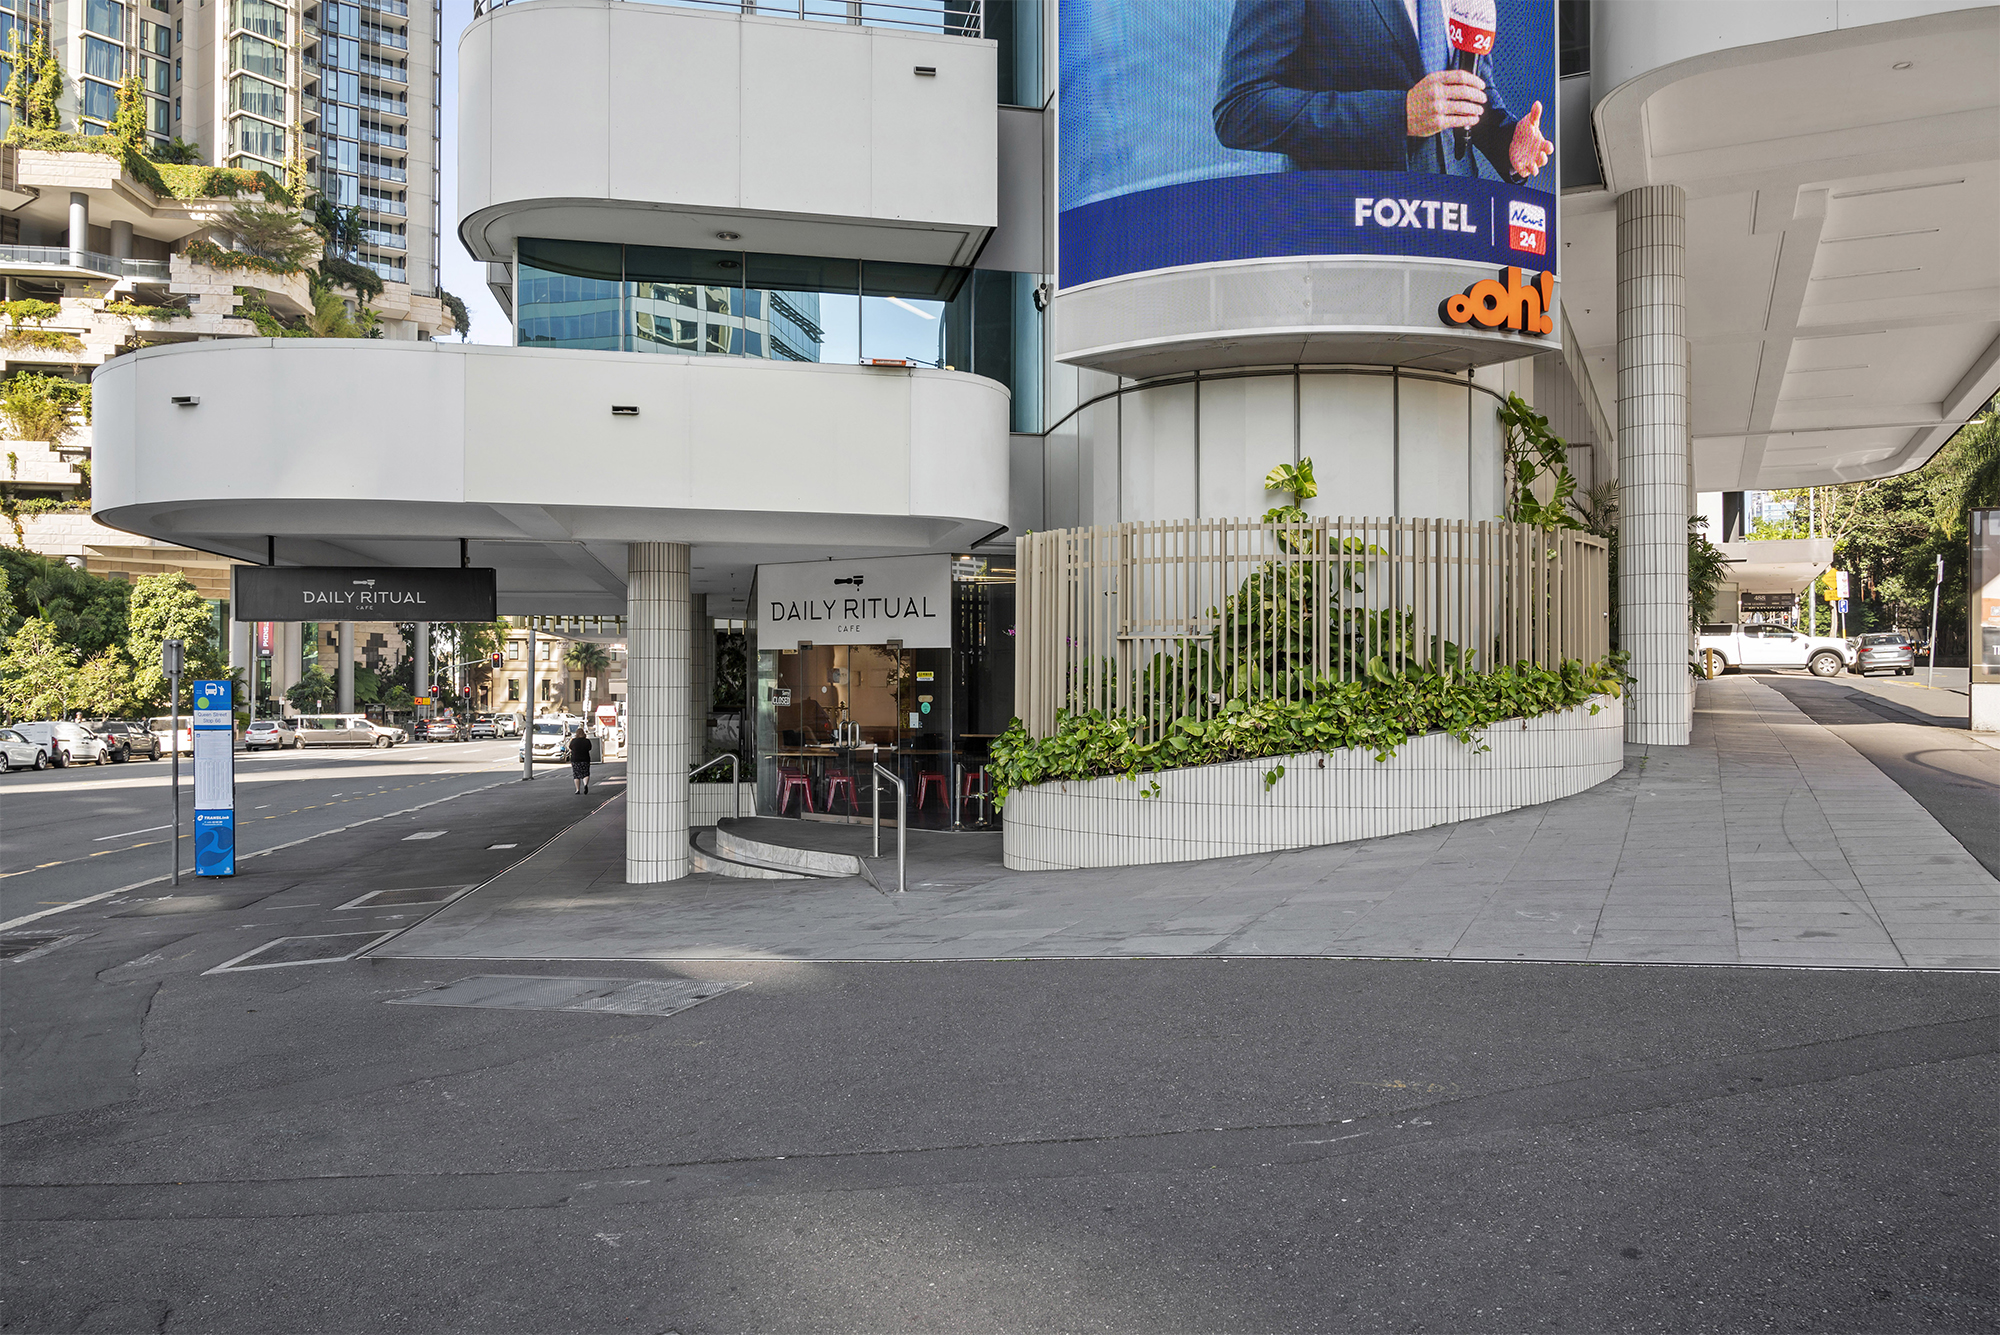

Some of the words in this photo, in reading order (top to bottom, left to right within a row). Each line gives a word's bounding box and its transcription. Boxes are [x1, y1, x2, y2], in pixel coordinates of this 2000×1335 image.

[1450, 25, 1463, 43] 24
[1473, 34, 1491, 50] 24
[1355, 198, 1477, 233] FOXTEL
[1511, 208, 1544, 228] News
[1519, 231, 1537, 249] 24
[303, 591, 355, 604] DAILY
[361, 591, 426, 604] RITUAL
[770, 600, 836, 622] DAILY
[844, 596, 936, 620] RITUAL
[837, 624, 861, 633] CAFE
[772, 696, 790, 704] CLOSED
